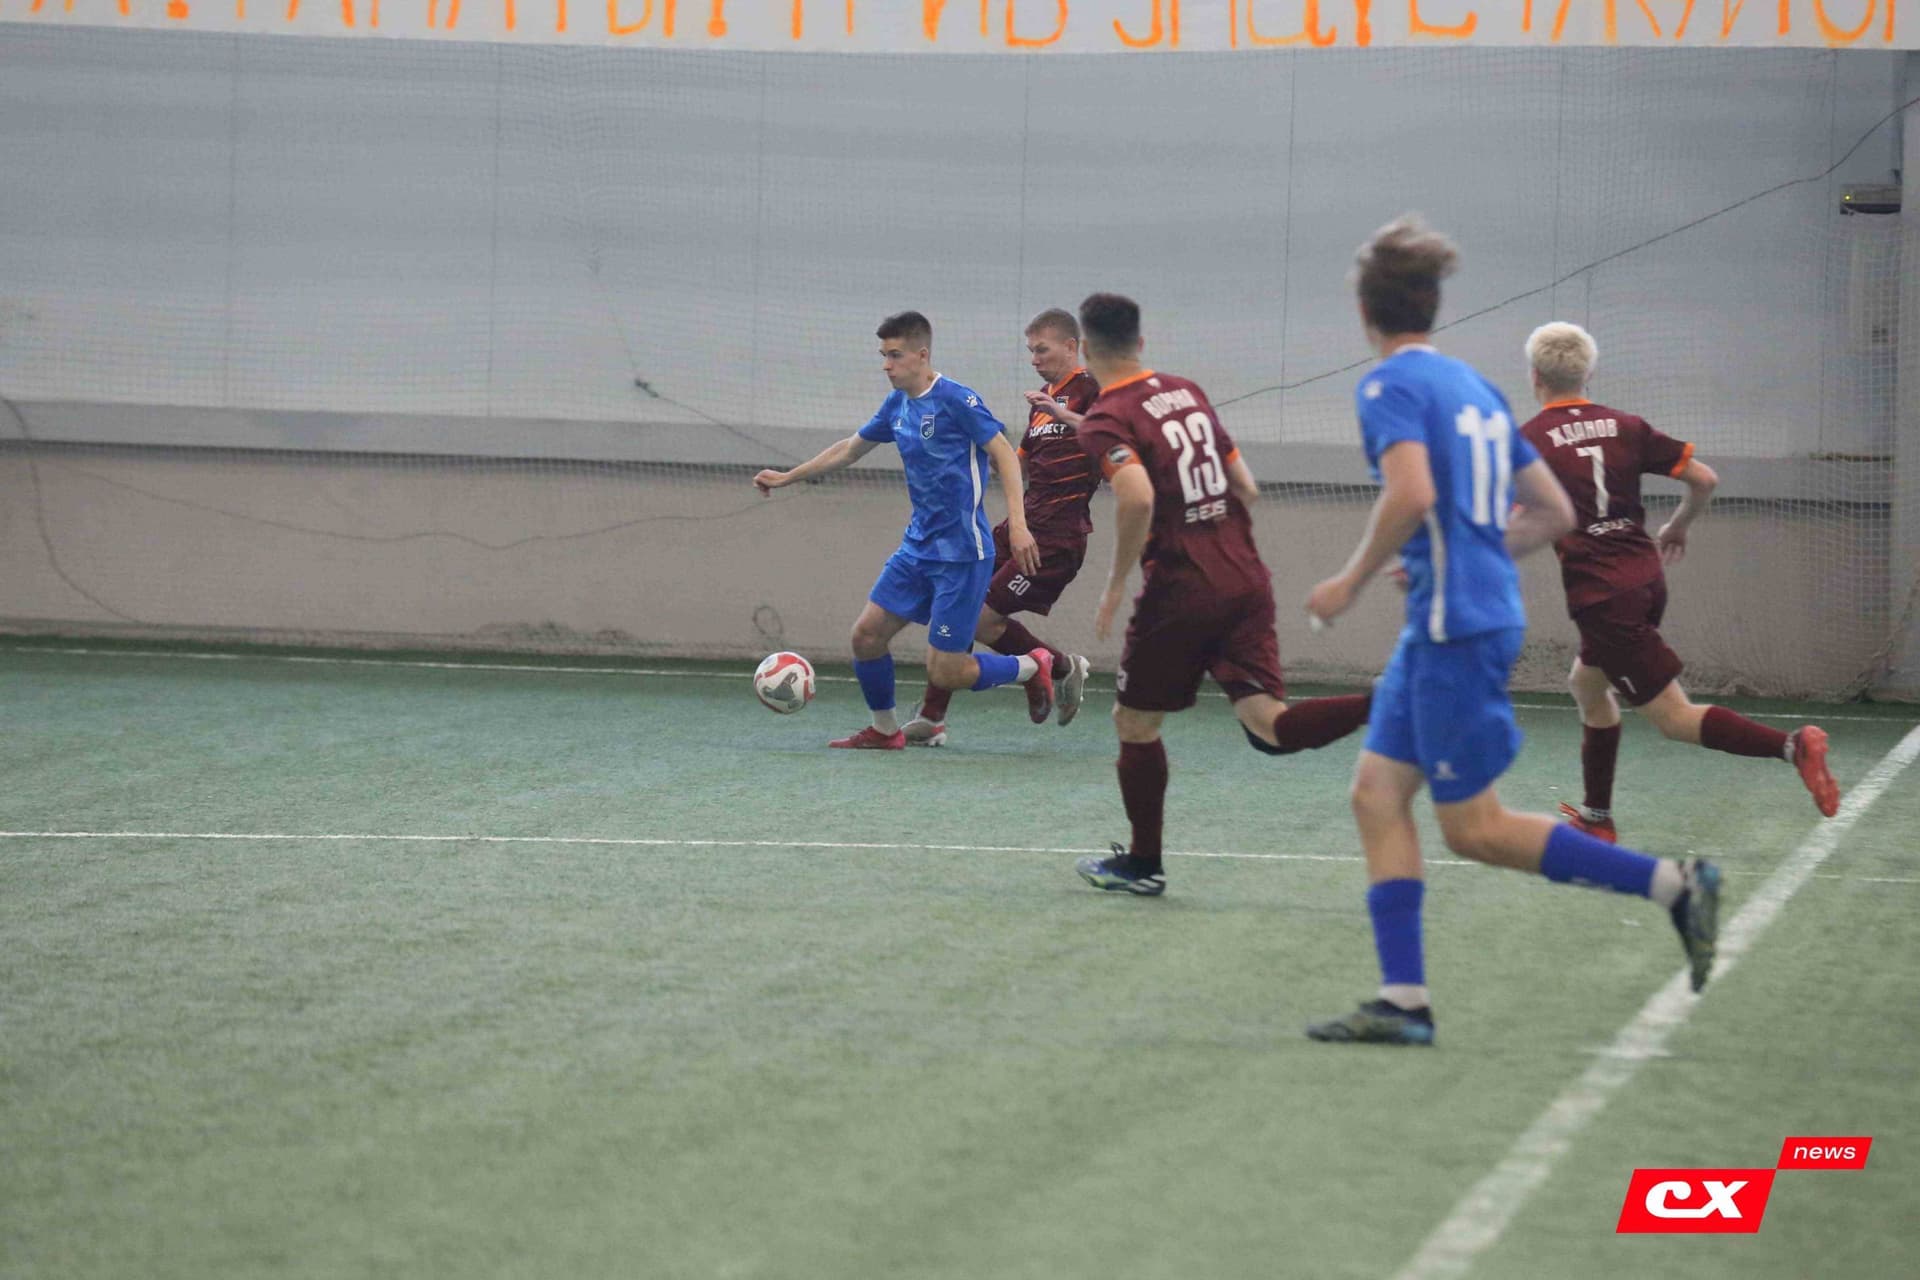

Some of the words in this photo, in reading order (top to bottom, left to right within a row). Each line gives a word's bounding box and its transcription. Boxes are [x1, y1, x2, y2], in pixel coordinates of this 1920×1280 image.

[1162, 412, 1228, 504] 23
[1456, 405, 1511, 530] 11
[1546, 418, 1618, 447] ЖДАНОВ
[1576, 446, 1609, 518] 7
[1008, 574, 1031, 596] 20
